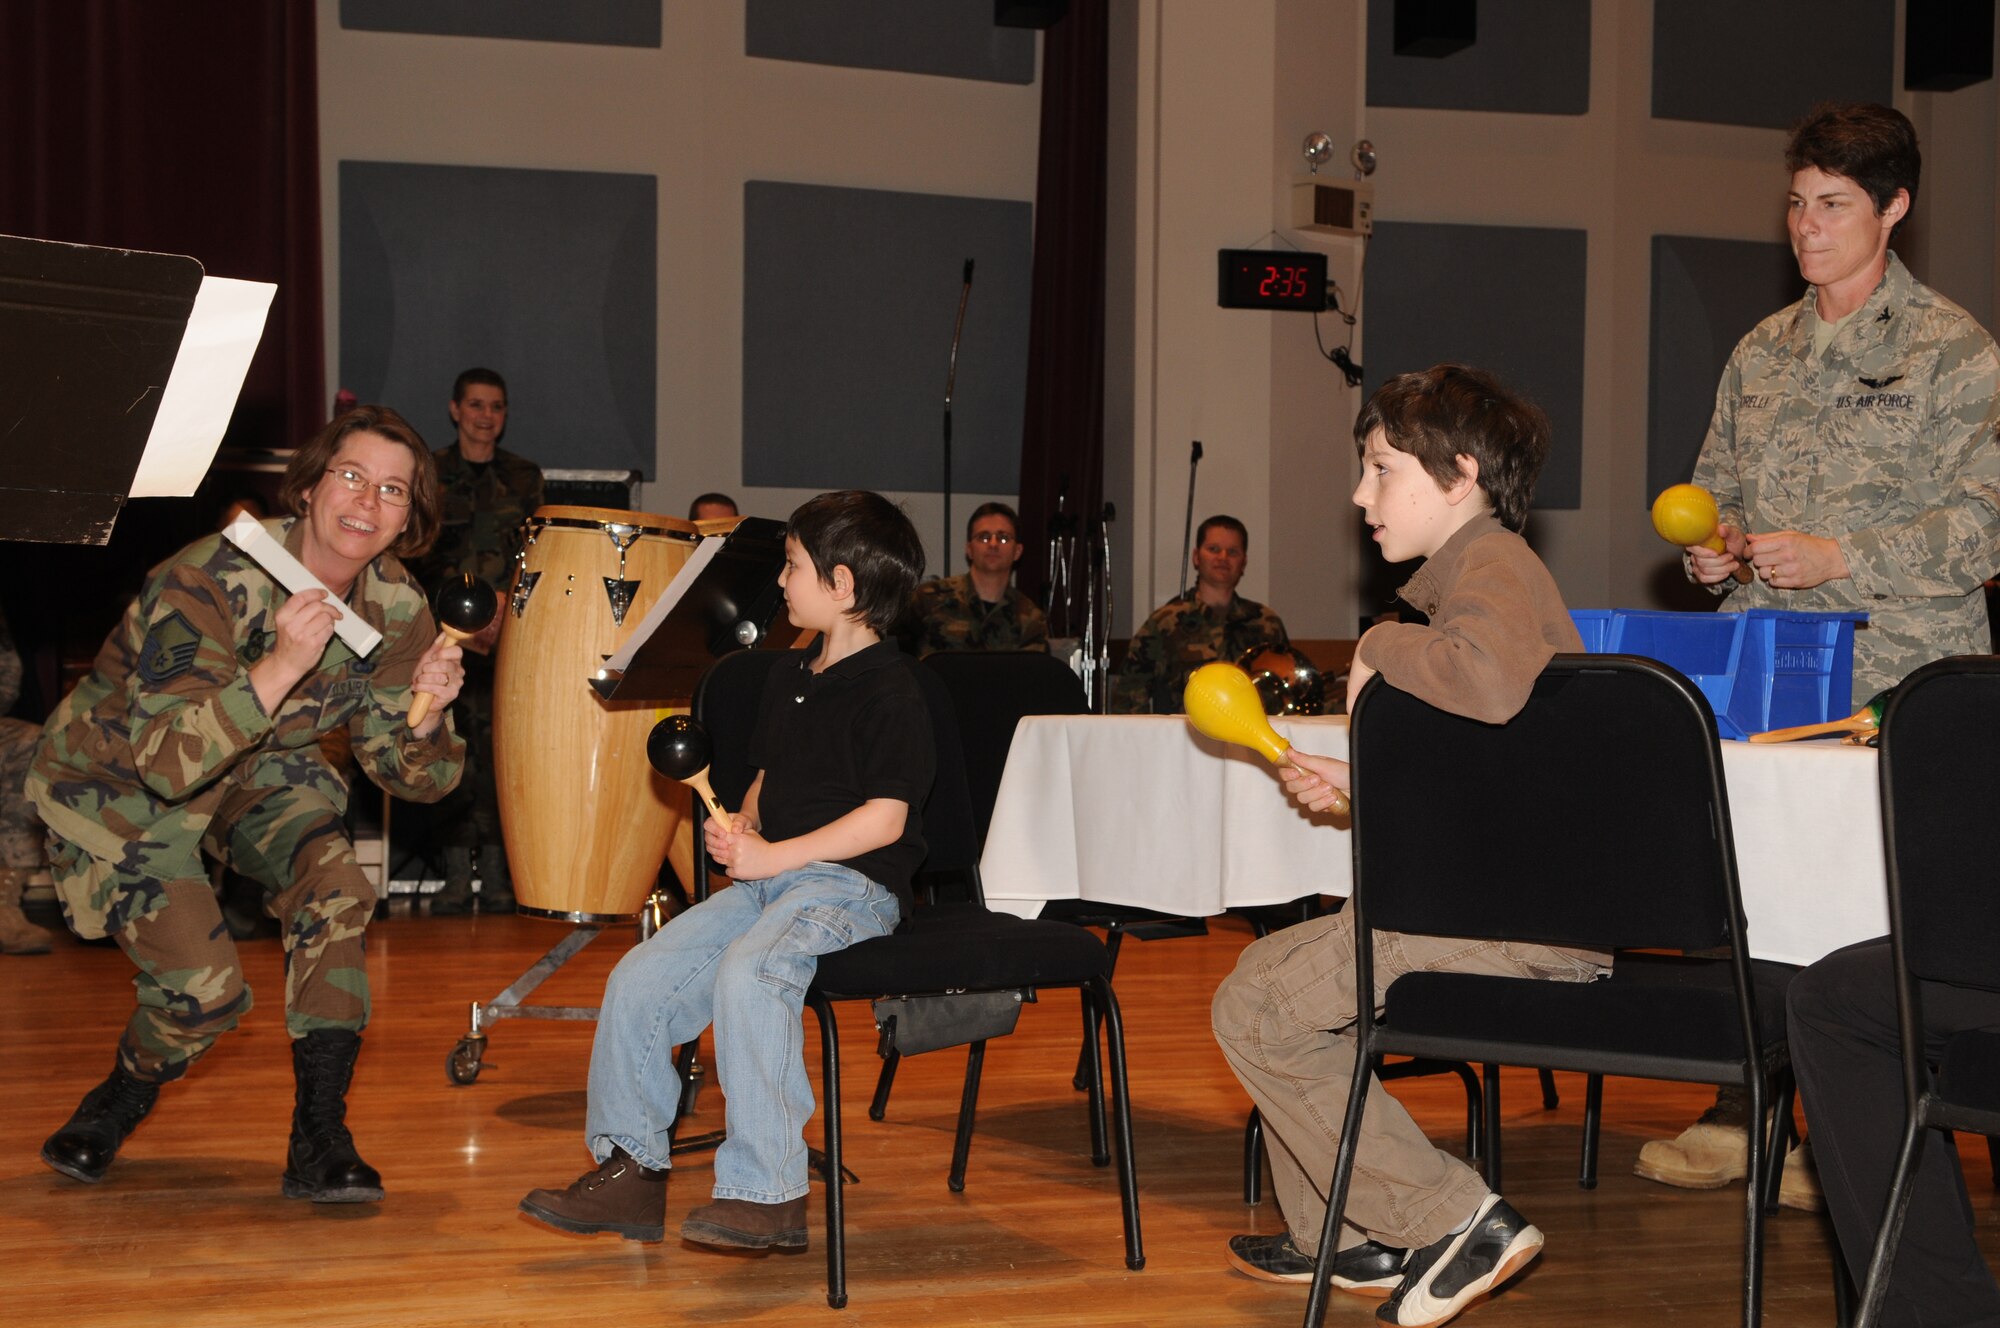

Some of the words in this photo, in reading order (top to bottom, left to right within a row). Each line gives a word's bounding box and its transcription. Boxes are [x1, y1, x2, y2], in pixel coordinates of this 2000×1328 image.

[1259, 266, 1308, 297] 2:35
[1856, 395, 1876, 408] AIR
[1878, 393, 1915, 409] FORCE
